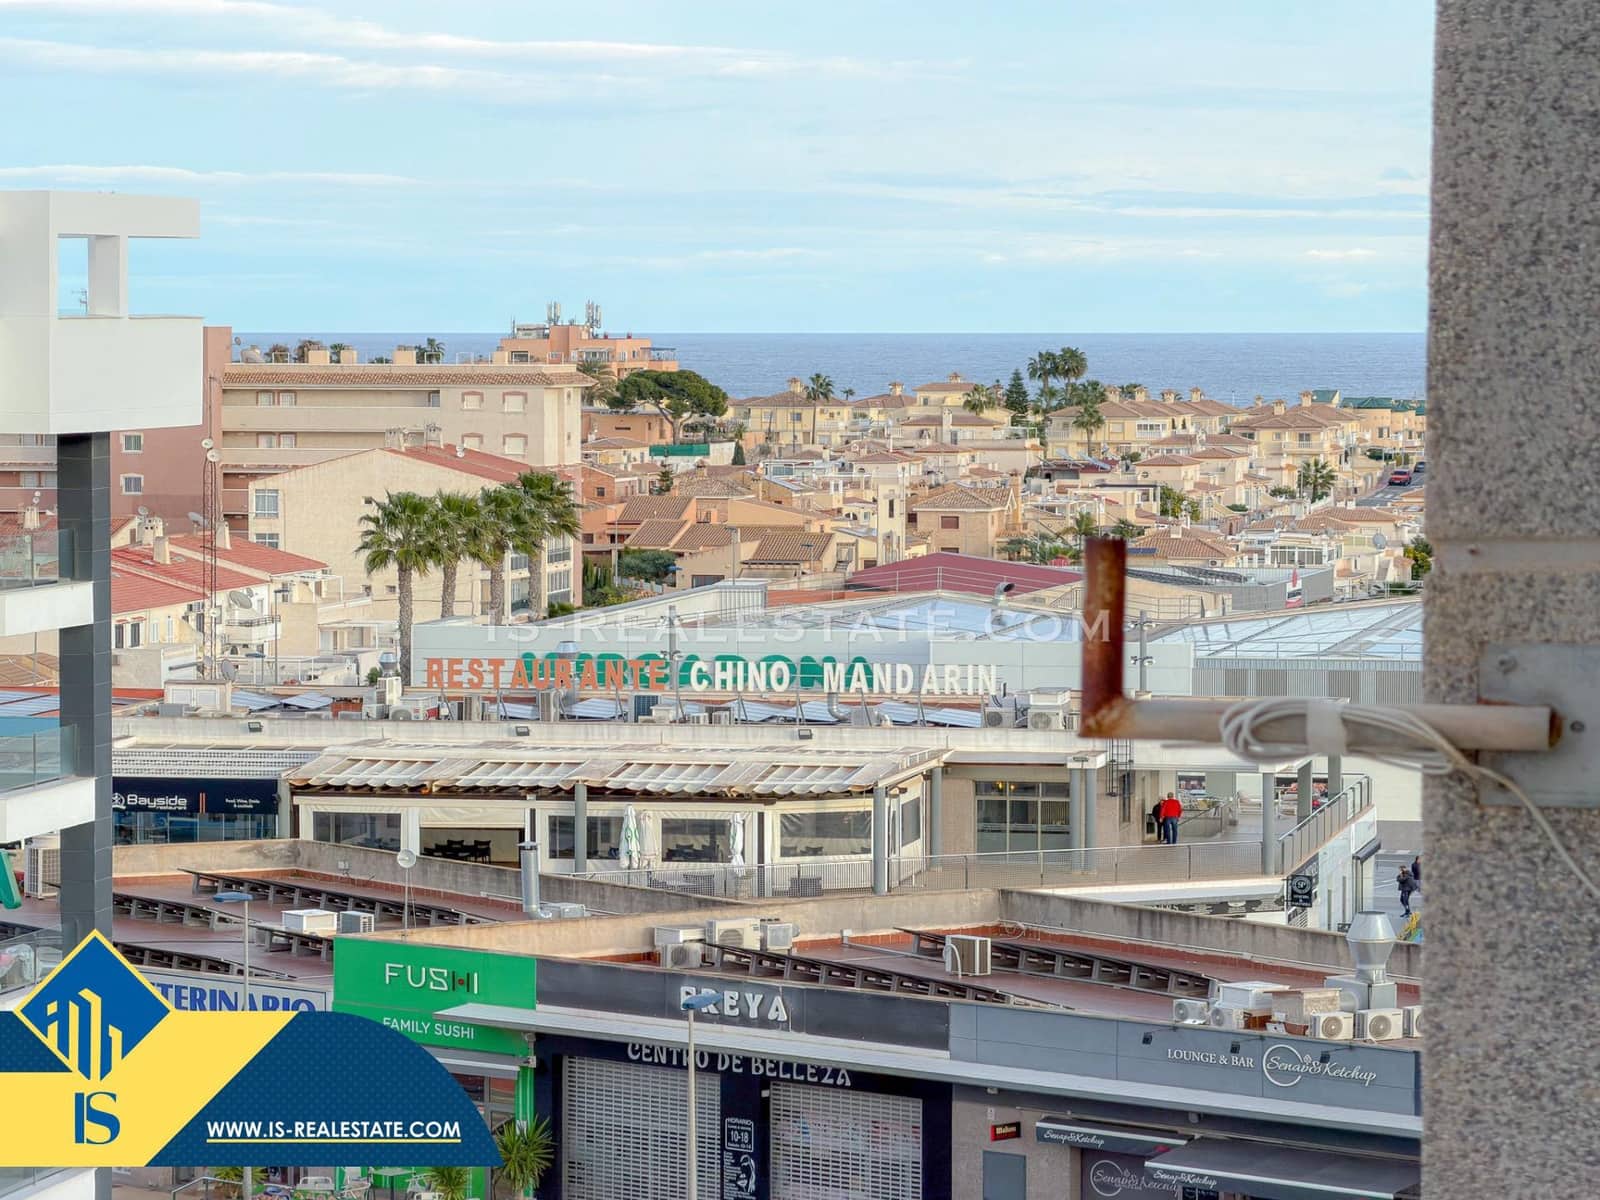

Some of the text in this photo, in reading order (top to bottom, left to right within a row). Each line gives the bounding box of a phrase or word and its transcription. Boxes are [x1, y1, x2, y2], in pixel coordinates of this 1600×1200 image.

[426, 657, 998, 696] RESTAURANTE CHINO MANDARIN
[127, 794, 187, 808] Bayside
[384, 962, 479, 995] FUSHI
[383, 1017, 475, 1041] FAMILY SUSHI
[717, 1053, 744, 1073] DE
[751, 1056, 852, 1087] BELLEZA
[1167, 1048, 1255, 1069] LOUNGE & BAR
